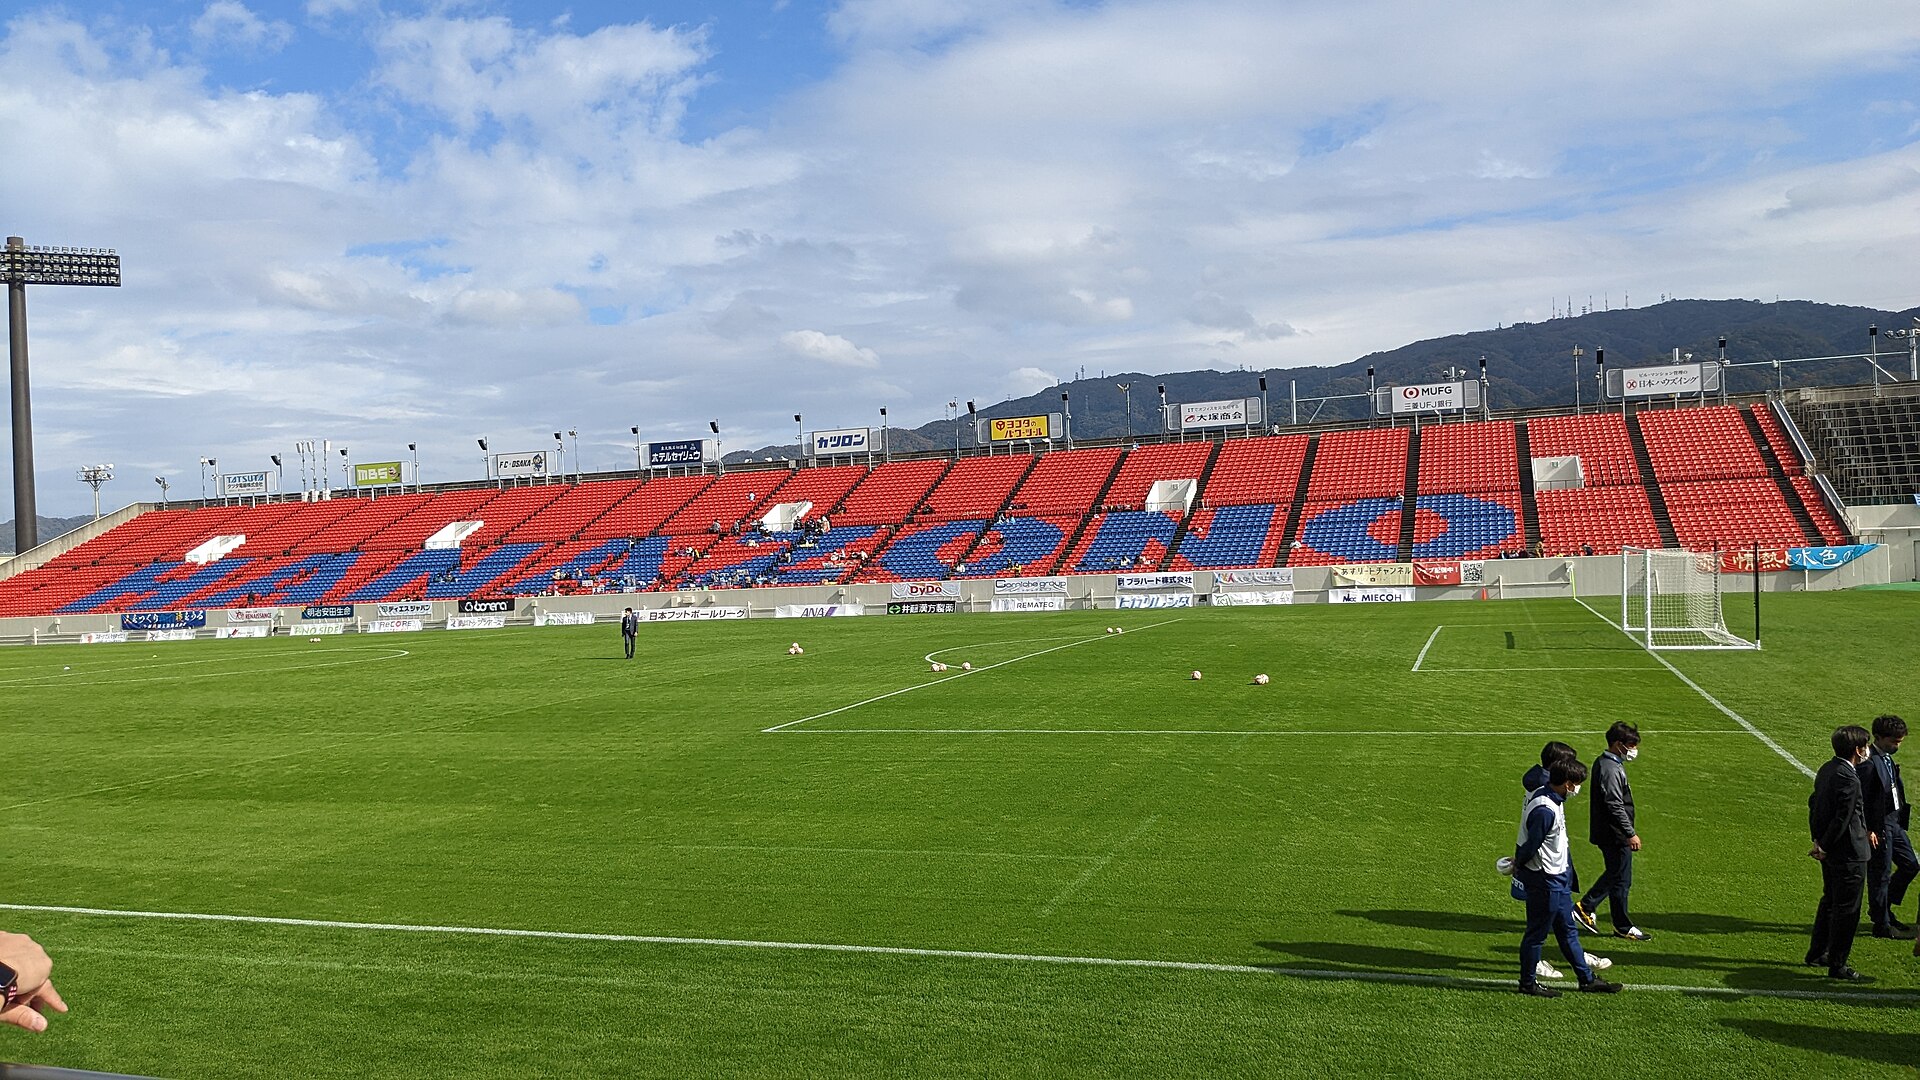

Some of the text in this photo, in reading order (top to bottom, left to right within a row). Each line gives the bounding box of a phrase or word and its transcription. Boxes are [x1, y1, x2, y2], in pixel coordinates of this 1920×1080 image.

[1638, 375, 1699, 388] 日本ハウズイング
[1421, 386, 1452, 396] MUFG
[1404, 400, 1452, 410] 三菱UFJ銀行
[1197, 411, 1242, 421] 大塚商会
[1006, 419, 1036, 429] ヨコタの
[1005, 428, 1042, 438] パワーツール
[817, 433, 865, 449] カツロン
[651, 450, 700, 462] ホテルセイリュウ
[226, 475, 264, 483] TATSUTA
[357, 468, 387, 481] MBS
[1341, 566, 1411, 576] あすリートチャンネル
[1039, 580, 1066, 588] group
[1126, 576, 1192, 585] プラハード株式会社
[909, 585, 942, 595] DyDo
[1361, 593, 1402, 602] MIECOH
[307, 606, 351, 617] 明治安田生命
[649, 609, 746, 620] 日本フットボールリーグ
[801, 607, 825, 617] ANA
